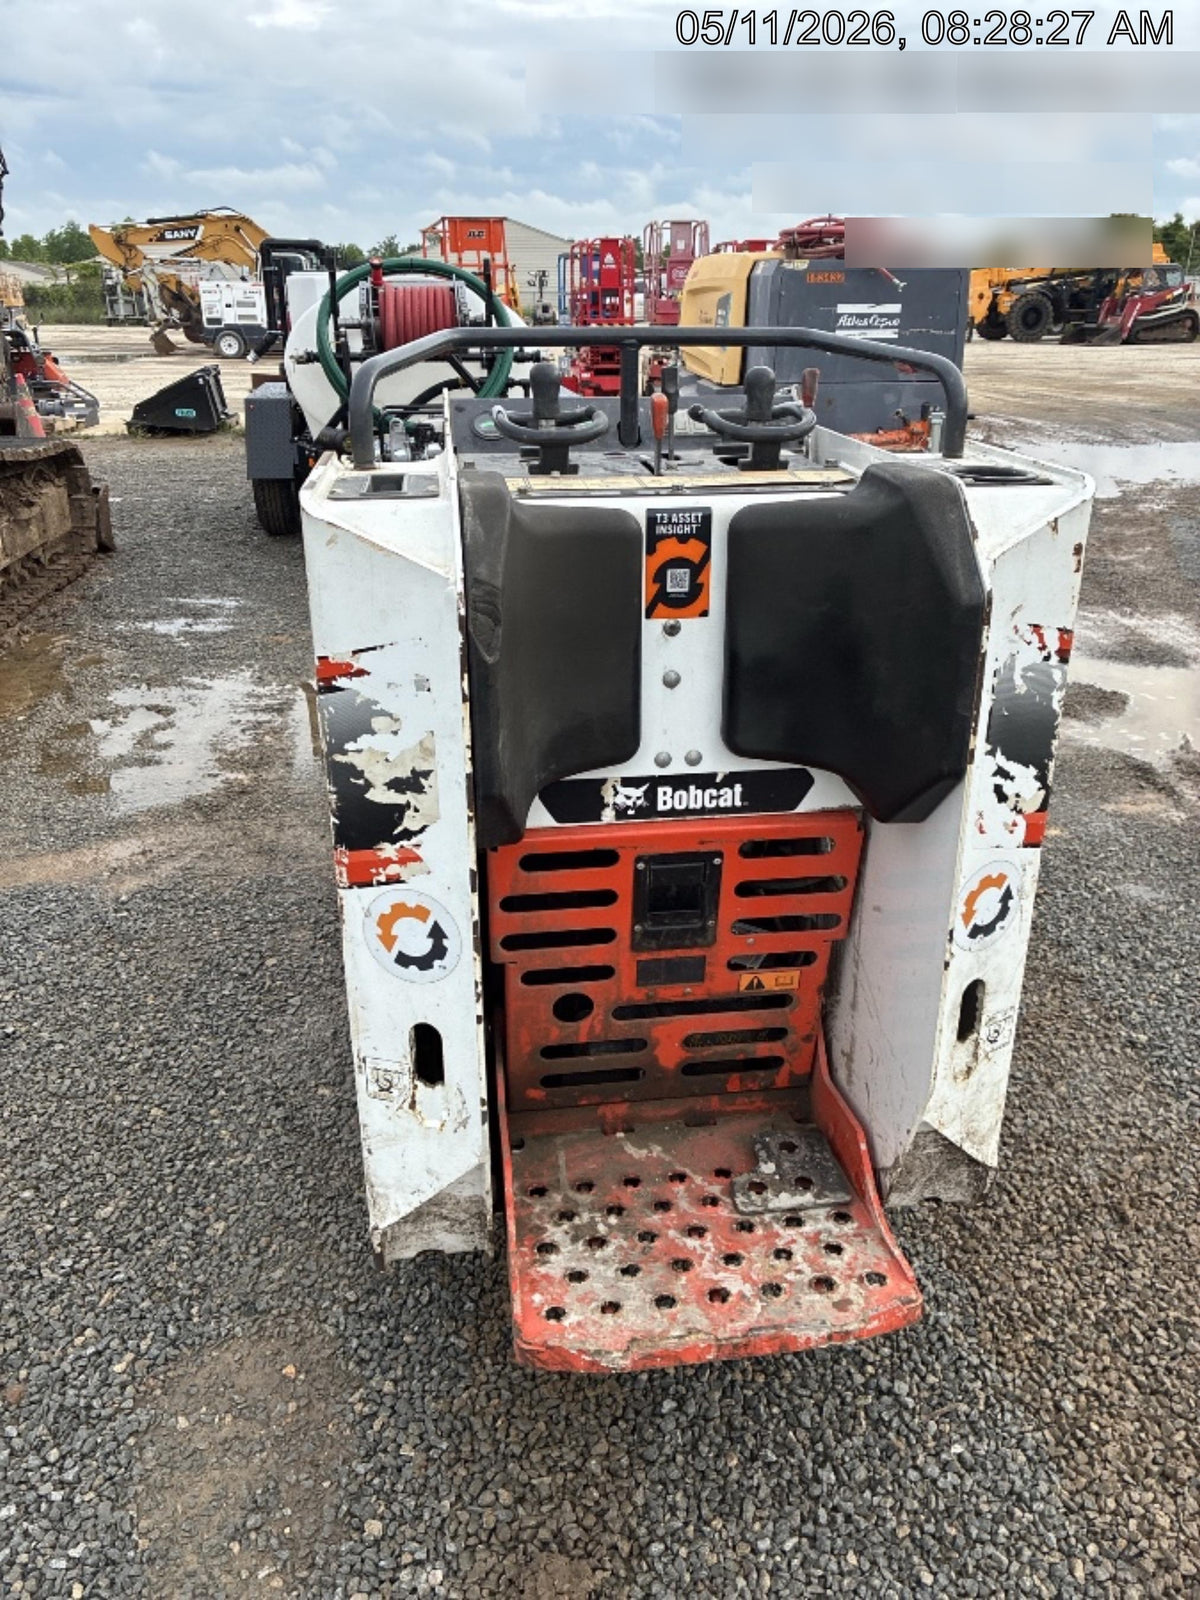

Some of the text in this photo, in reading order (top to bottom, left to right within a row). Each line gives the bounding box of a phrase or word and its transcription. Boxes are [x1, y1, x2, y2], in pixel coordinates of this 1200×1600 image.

[164, 228, 197, 239] SANY
[655, 511, 703, 524] T3 ASSET
[656, 783, 743, 812] Bobcat
